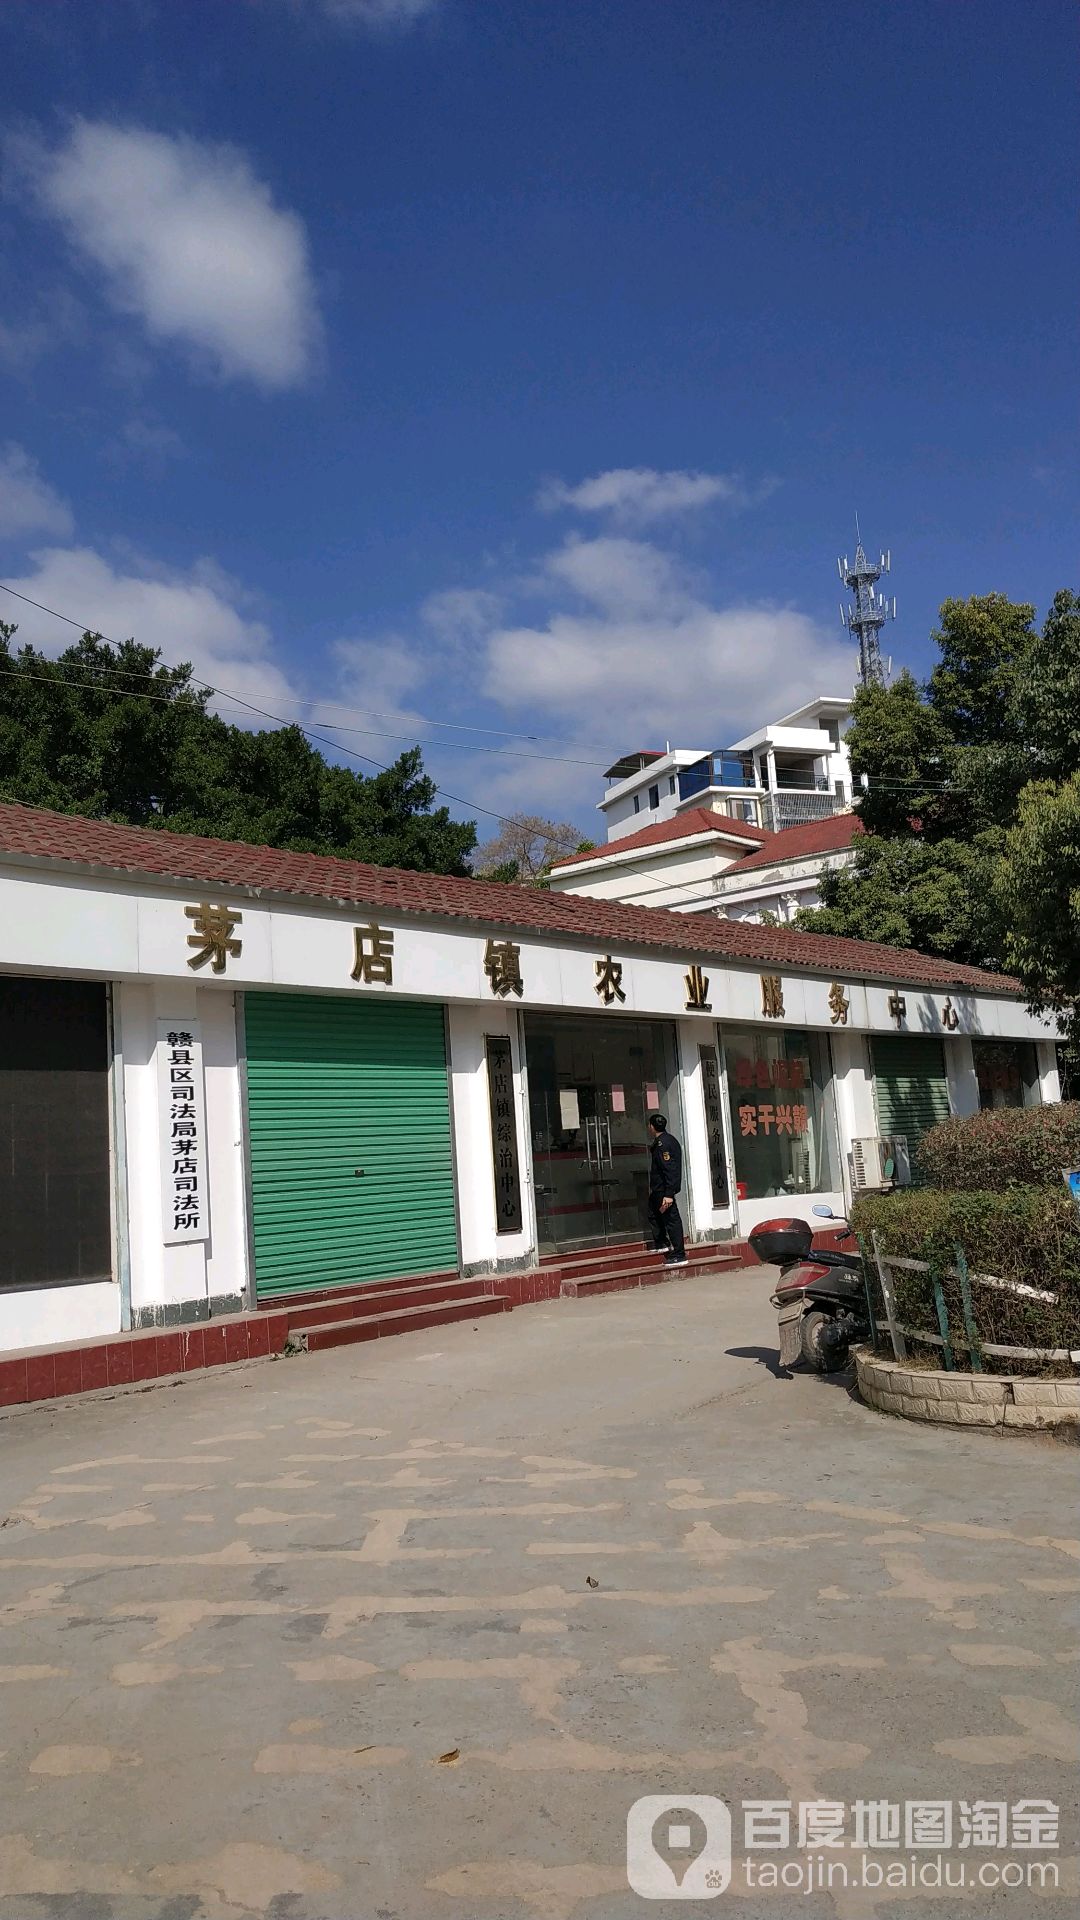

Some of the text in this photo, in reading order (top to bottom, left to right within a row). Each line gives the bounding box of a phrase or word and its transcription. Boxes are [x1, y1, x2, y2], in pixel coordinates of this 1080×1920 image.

[184, 901, 960, 1032] 茅店镇农业服务中心
[166, 1031, 201, 1230] 赣县区司法局茅店司法所
[494, 1049, 516, 1218] 茅店镇综治中心
[705, 1061, 725, 1190] 便民服务中心
